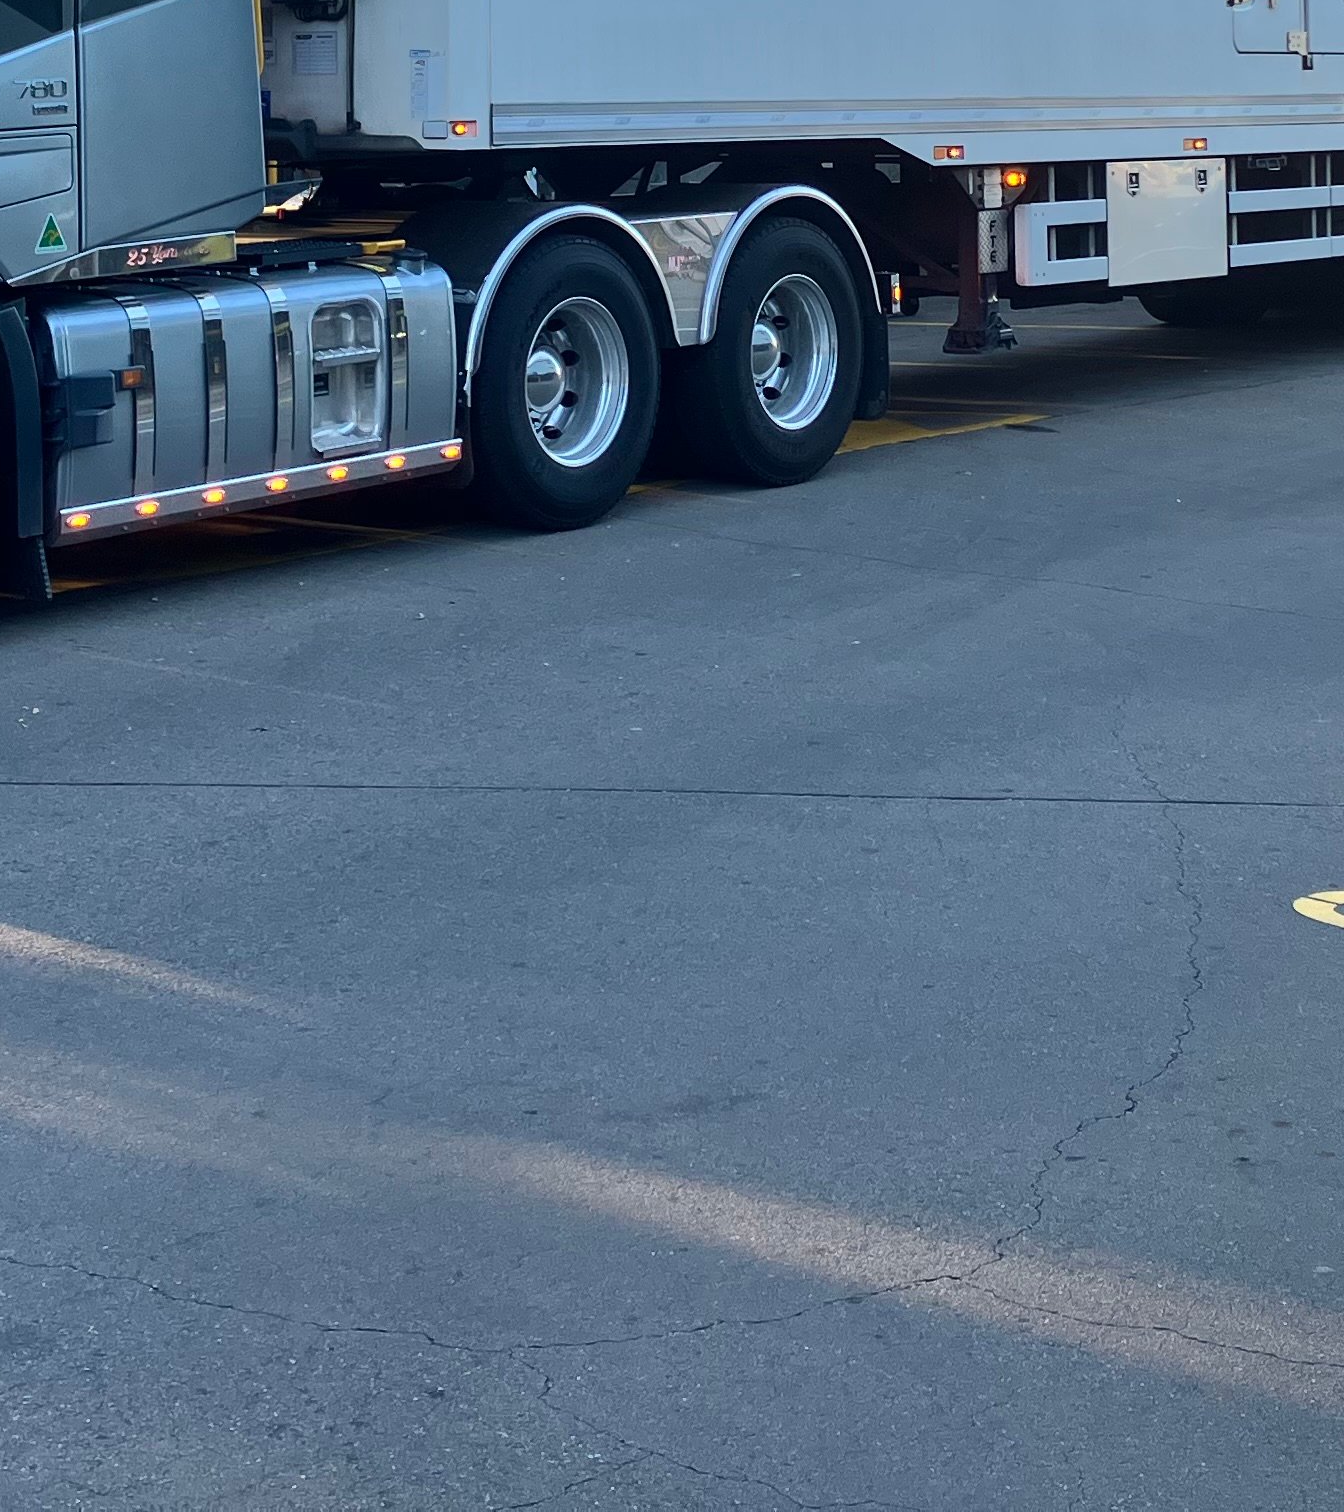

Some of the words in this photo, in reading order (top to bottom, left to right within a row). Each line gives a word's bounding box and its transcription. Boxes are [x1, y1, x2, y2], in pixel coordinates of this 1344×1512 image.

[13, 80, 68, 100] 780
[989, 219, 997, 264] FTE
[126, 248, 149, 266] 25
